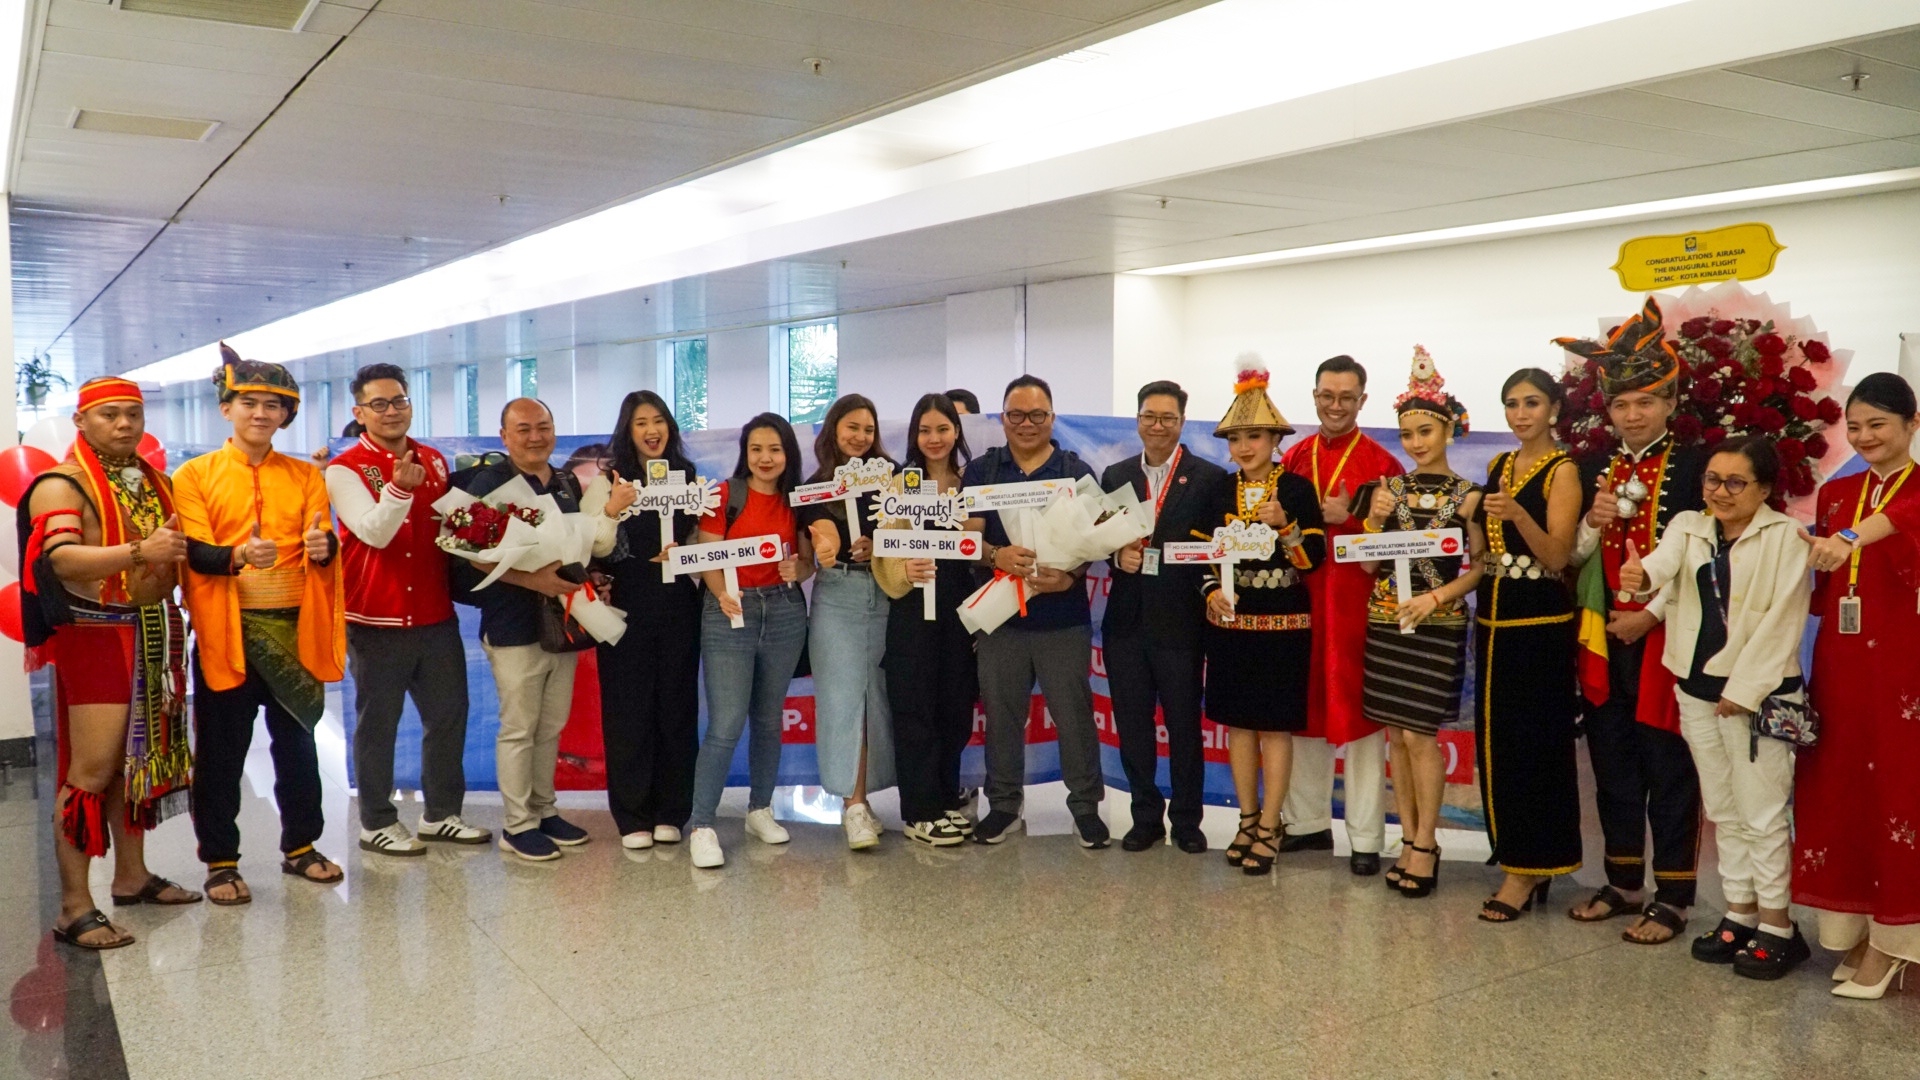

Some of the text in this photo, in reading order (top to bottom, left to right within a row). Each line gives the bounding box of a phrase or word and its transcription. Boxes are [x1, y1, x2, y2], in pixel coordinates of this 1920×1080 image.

[1646, 248, 1746, 266] CONGRATULATIONS AIRASIA
[1668, 263, 1710, 272] INAUGURAL
[1712, 259, 1737, 267] FLIGHT
[1654, 275, 1674, 283] HCMC
[1680, 272, 1698, 280] KOTA
[1700, 268, 1737, 278] KINABALU
[842, 467, 893, 488] Cheers!
[985, 493, 1027, 501] CONGRATULATIONS
[884, 497, 952, 526] Congrats!
[884, 538, 900, 548] BKI
[909, 540, 929, 550] SGN
[939, 541, 955, 550] BKI
[1220, 535, 1274, 557] Cheers!
[1359, 542, 1406, 550] CONGRATULATIONS
[680, 554, 698, 565] BKI
[707, 550, 729, 562] SGN
[738, 546, 755, 558] BKI
[1377, 549, 1408, 557] INAUGURAL
